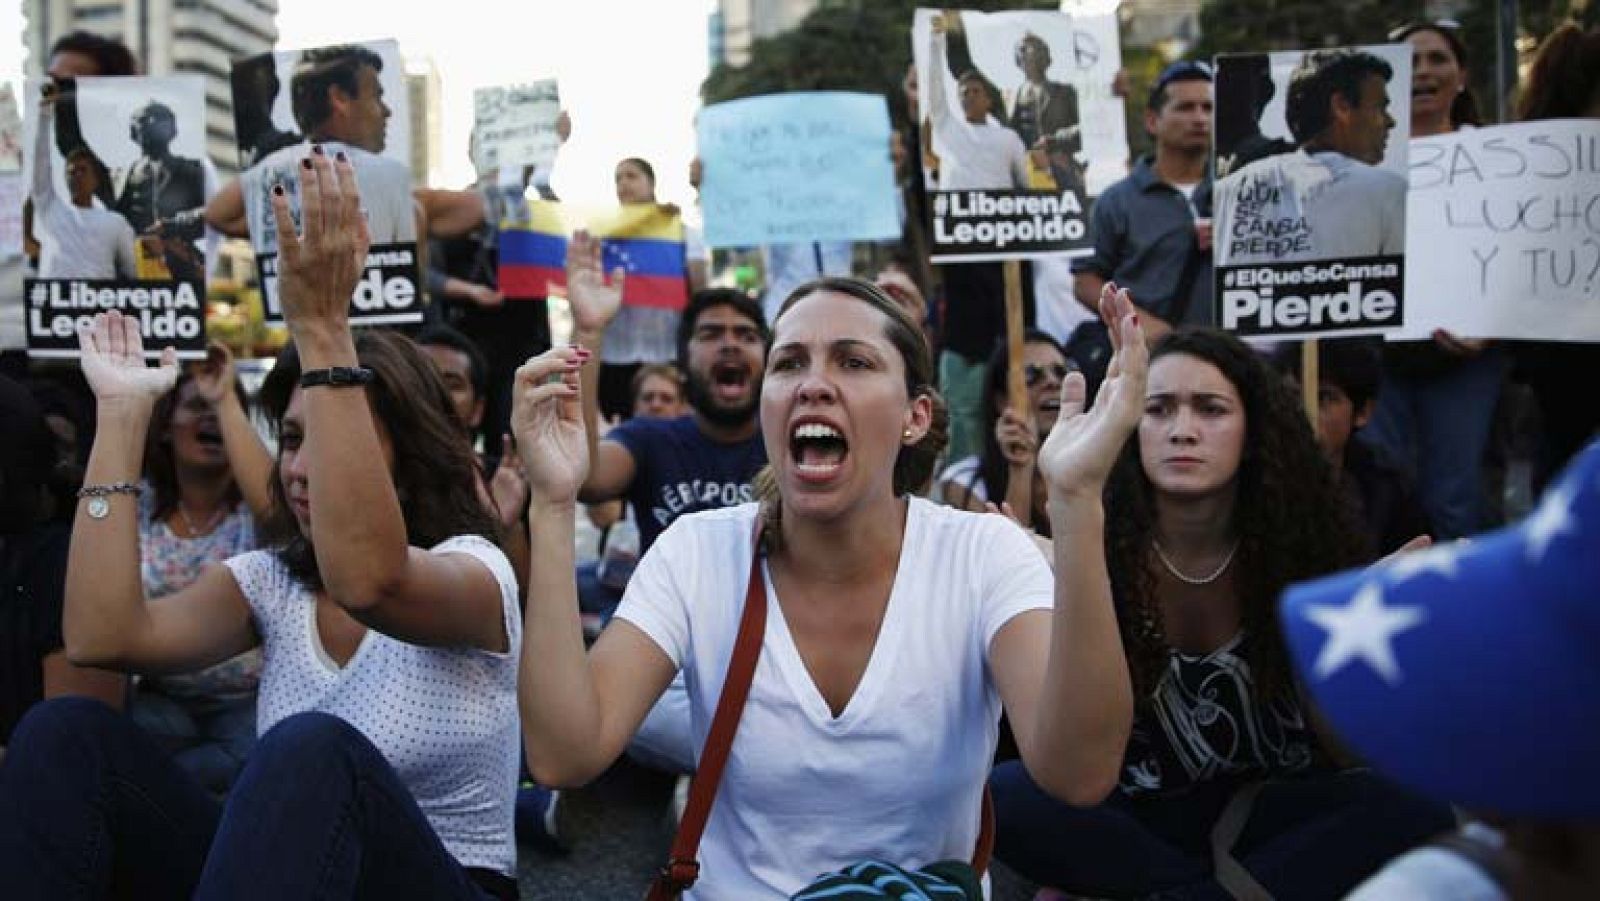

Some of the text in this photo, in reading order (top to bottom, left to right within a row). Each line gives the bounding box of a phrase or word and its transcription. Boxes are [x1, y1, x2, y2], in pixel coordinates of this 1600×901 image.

[932, 190, 1083, 216] #LiberenA
[932, 215, 1086, 247] Leopoldo
[1231, 217, 1312, 238] CANSA
[1472, 238, 1600, 295] Y TU?
[30, 281, 199, 309] #LiberenA
[1222, 281, 1397, 330] Pierde
[30, 308, 200, 338] Leoldo
